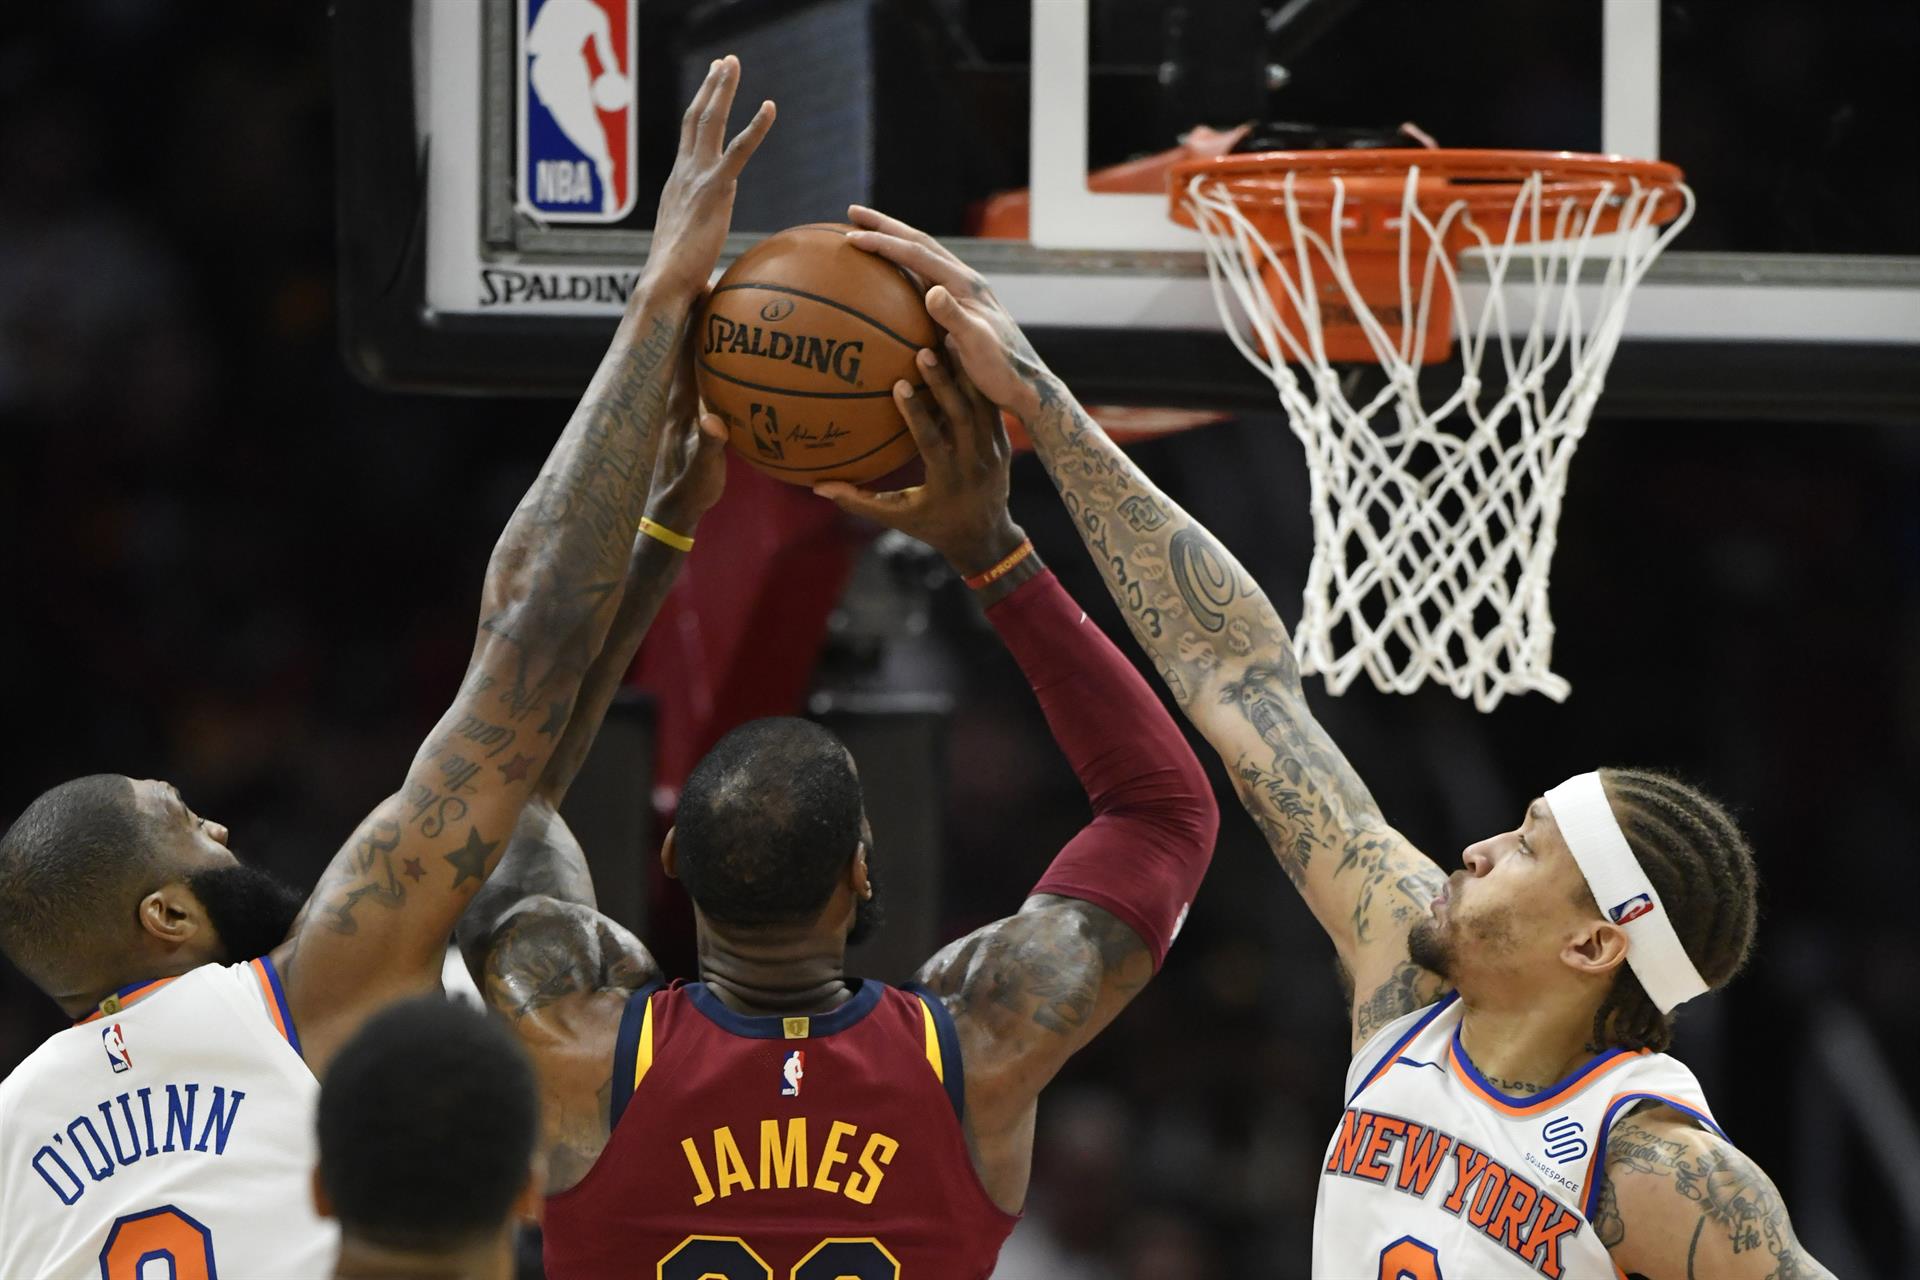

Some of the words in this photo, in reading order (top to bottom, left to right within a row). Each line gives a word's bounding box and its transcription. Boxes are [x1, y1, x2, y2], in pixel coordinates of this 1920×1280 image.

[536, 160, 592, 204] NBA
[479, 269, 640, 305] SPALDIN
[704, 313, 864, 384] SPALDING
[32, 1083, 245, 1205] O'QUINN
[681, 1117, 899, 1206] JAMES
[1525, 1152, 1580, 1193] SQUARESPACE
[1325, 1107, 1454, 1200] NEW
[1440, 1137, 1585, 1280] YORK
